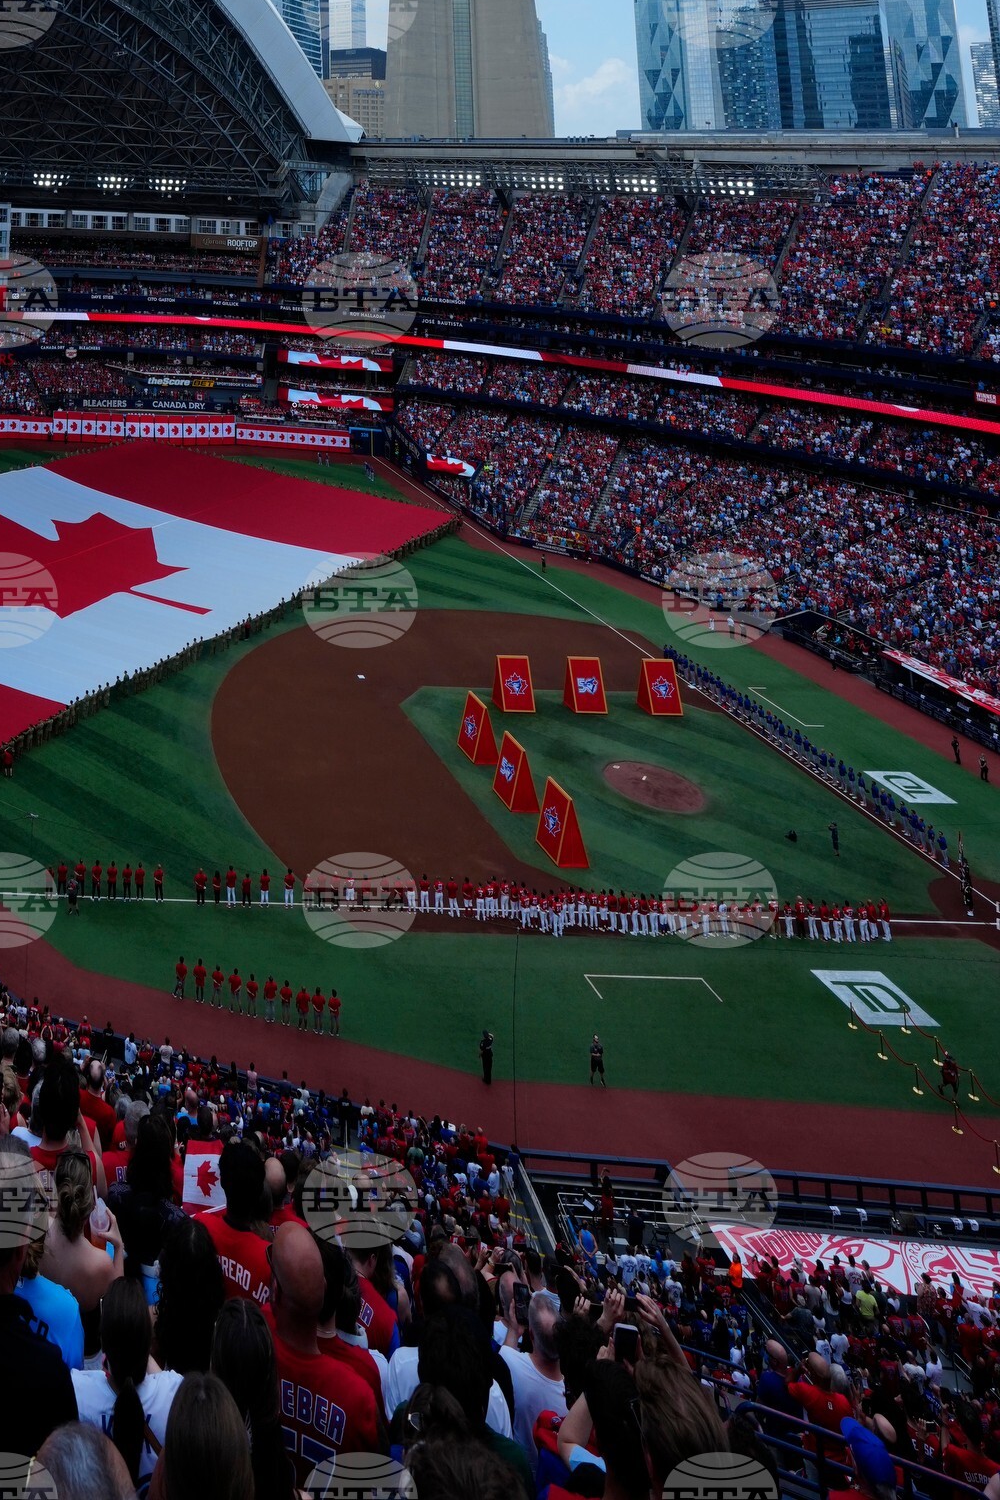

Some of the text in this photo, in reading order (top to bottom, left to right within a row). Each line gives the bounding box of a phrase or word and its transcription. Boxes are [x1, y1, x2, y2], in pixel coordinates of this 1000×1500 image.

[227, 239, 258, 247] ROOFTOP
[437, 319, 464, 328] BAUTISTA
[147, 377, 191, 386] theScore
[82, 399, 127, 408] BLEACHERS
[152, 401, 188, 409] CANADA
[830, 980, 911, 1014] TD
[281, 1378, 347, 1446] EBER
